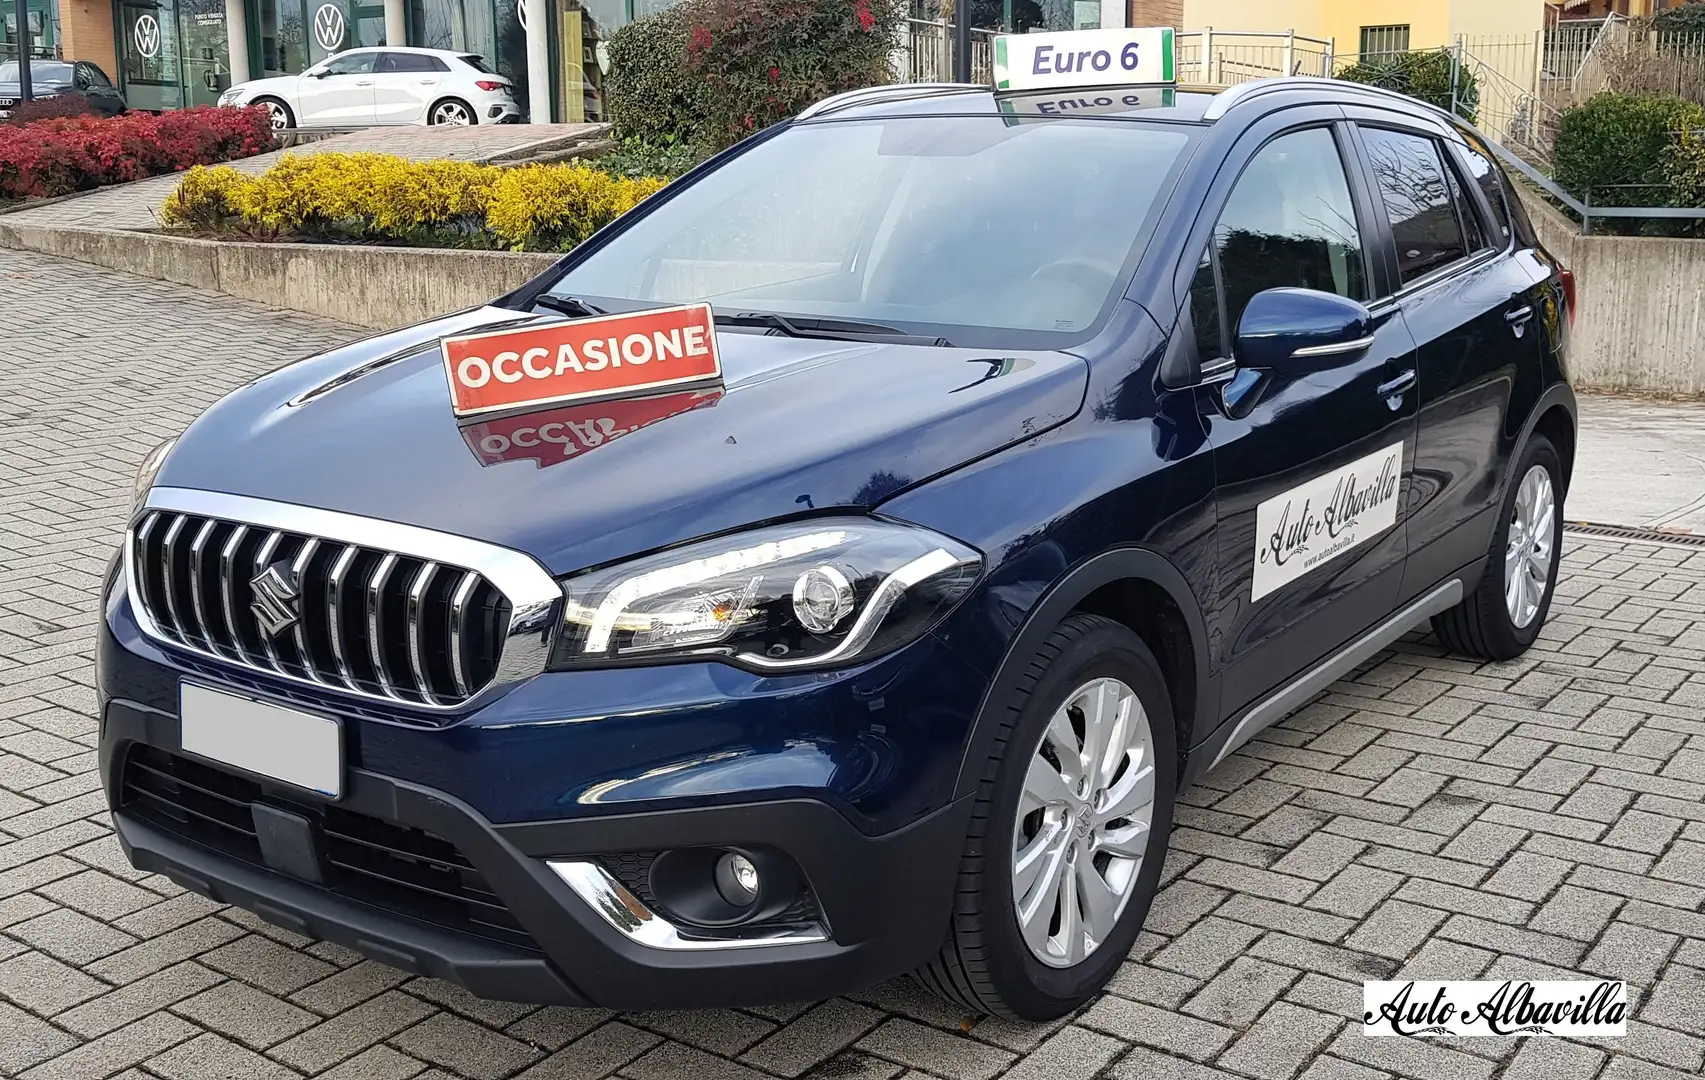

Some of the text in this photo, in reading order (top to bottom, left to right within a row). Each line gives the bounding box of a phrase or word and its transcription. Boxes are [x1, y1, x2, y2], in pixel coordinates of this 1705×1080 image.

[1032, 41, 1140, 75] Euro 6
[457, 325, 709, 389] OCCASIONE
[1260, 454, 1397, 567] Auto Albavilla
[1303, 533, 1356, 569] www.autoalbavilla.it
